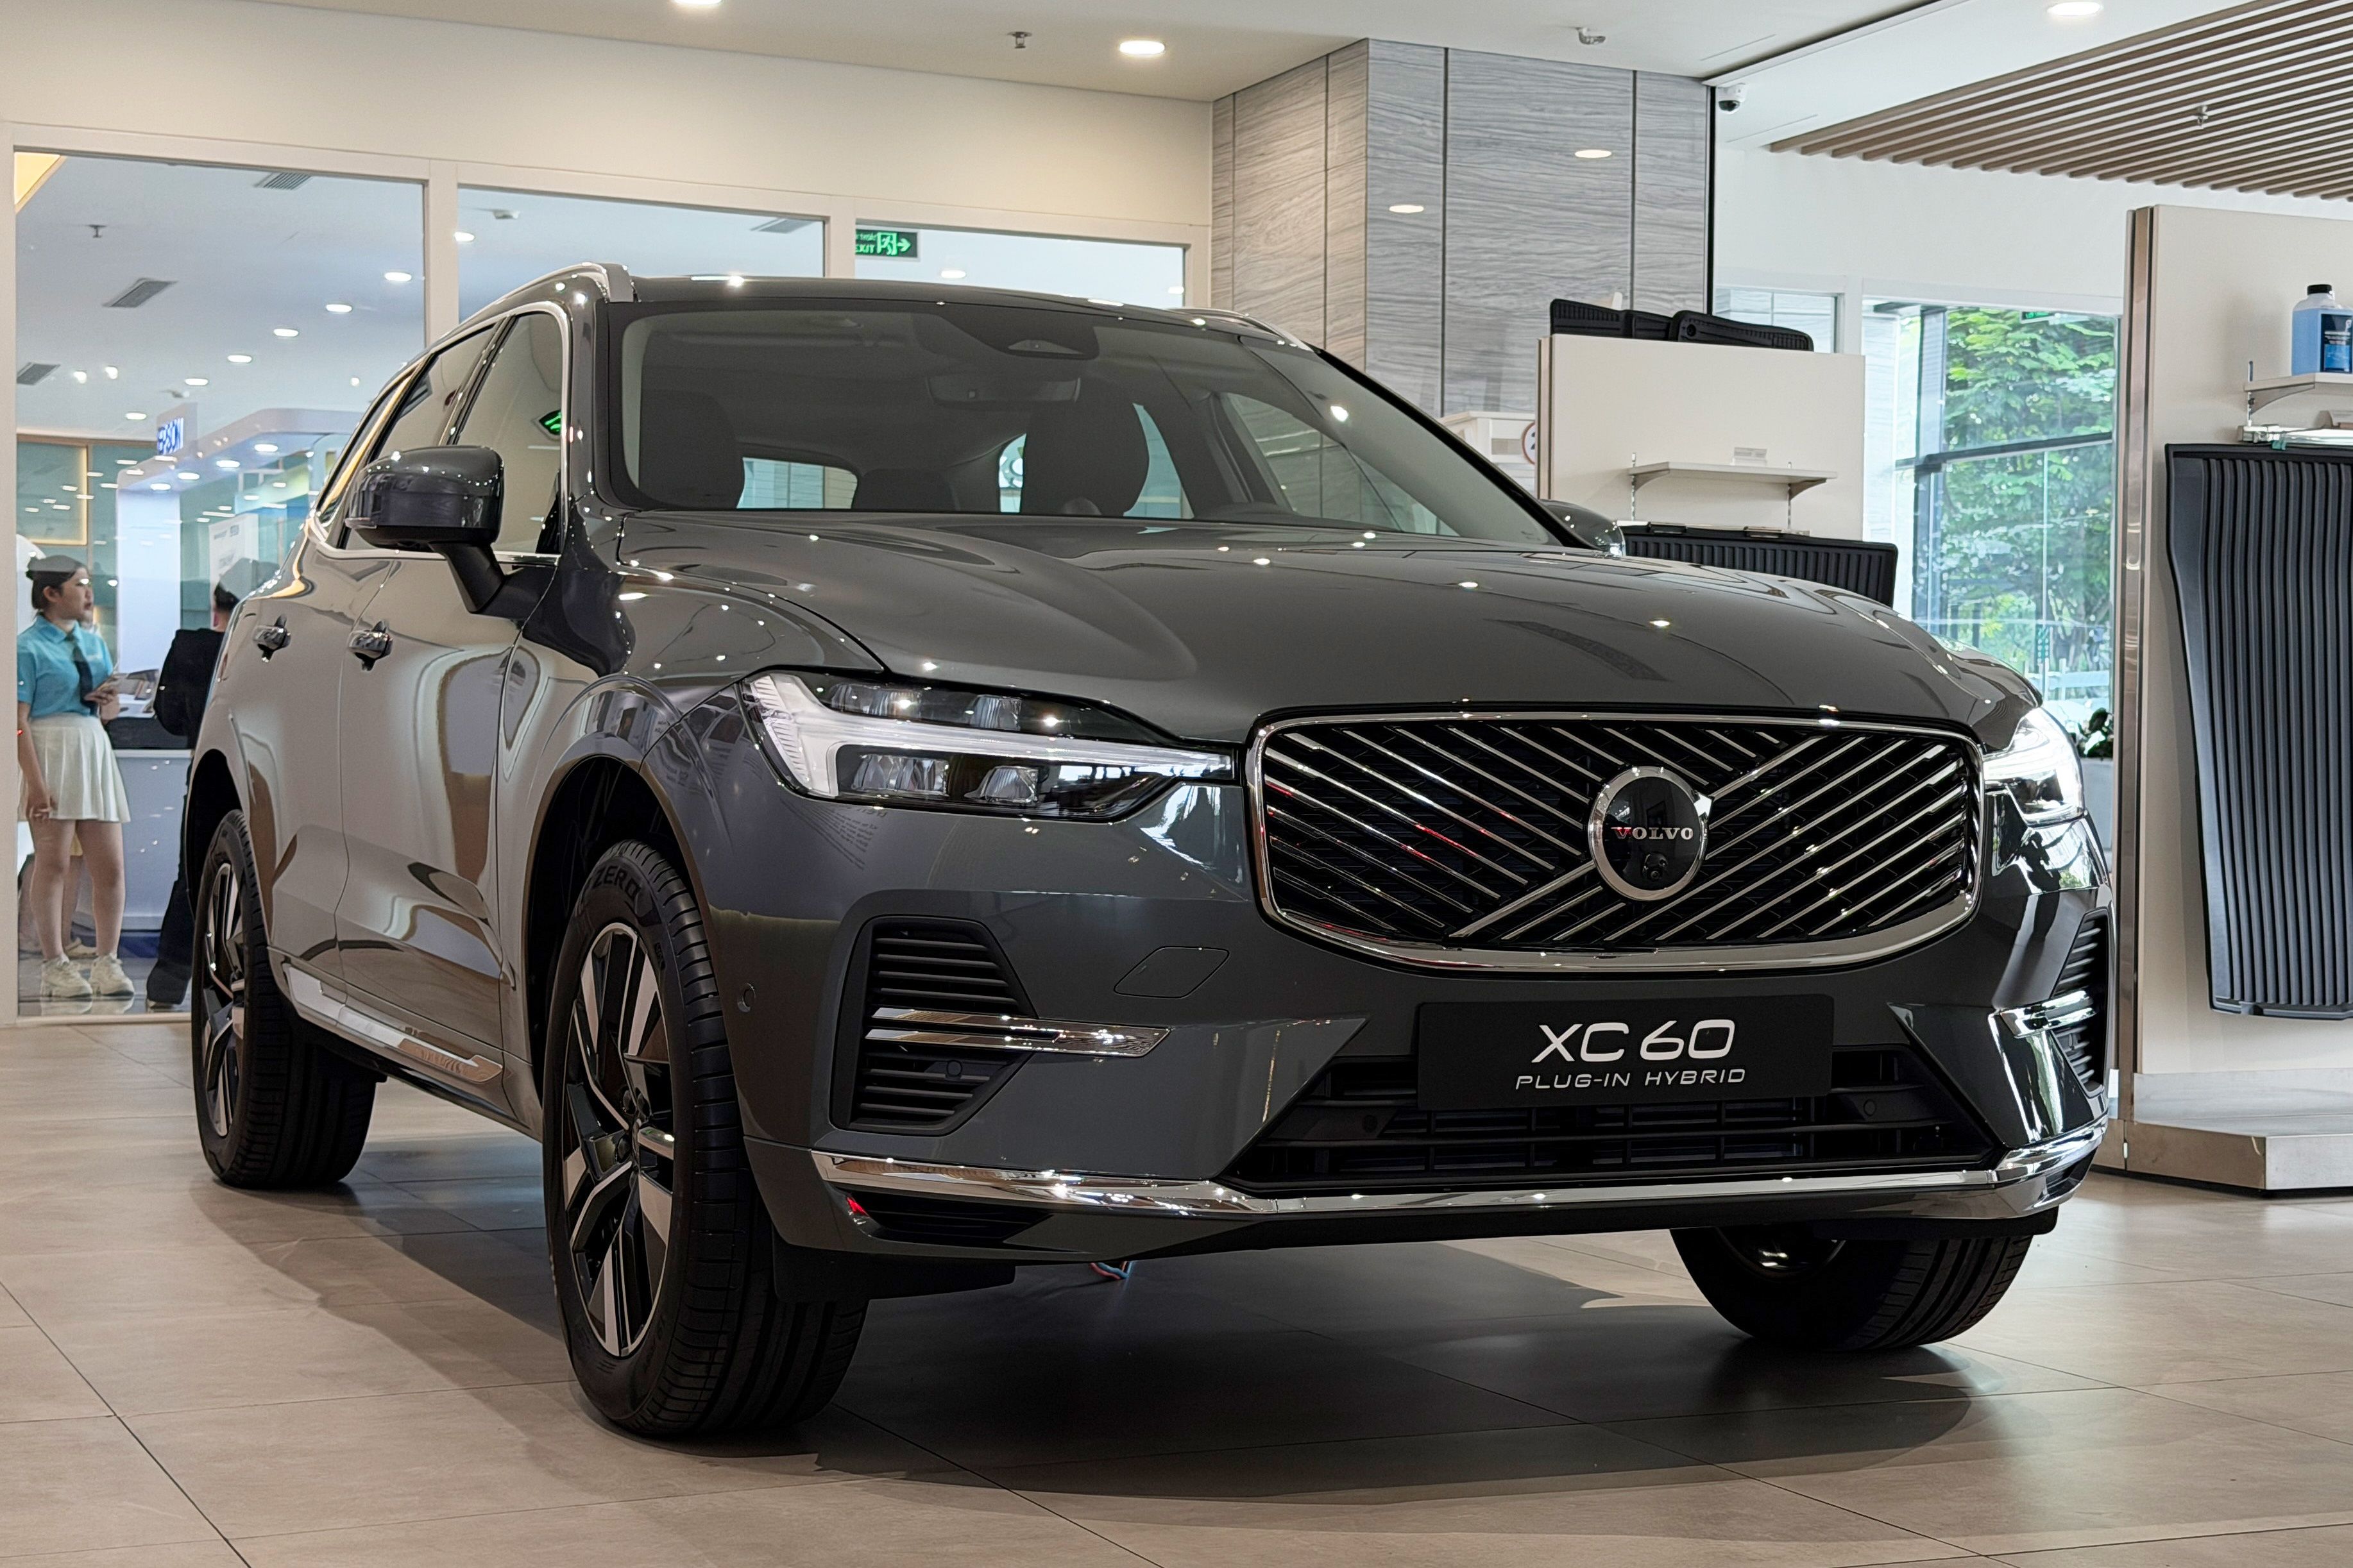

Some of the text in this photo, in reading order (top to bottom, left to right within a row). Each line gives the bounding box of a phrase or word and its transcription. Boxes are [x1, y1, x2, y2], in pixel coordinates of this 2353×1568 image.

[1611, 827, 1694, 840] VOLVO
[592, 865, 641, 900] ZERO
[1515, 1068, 1746, 1090] PLUG-IN HYBRID
